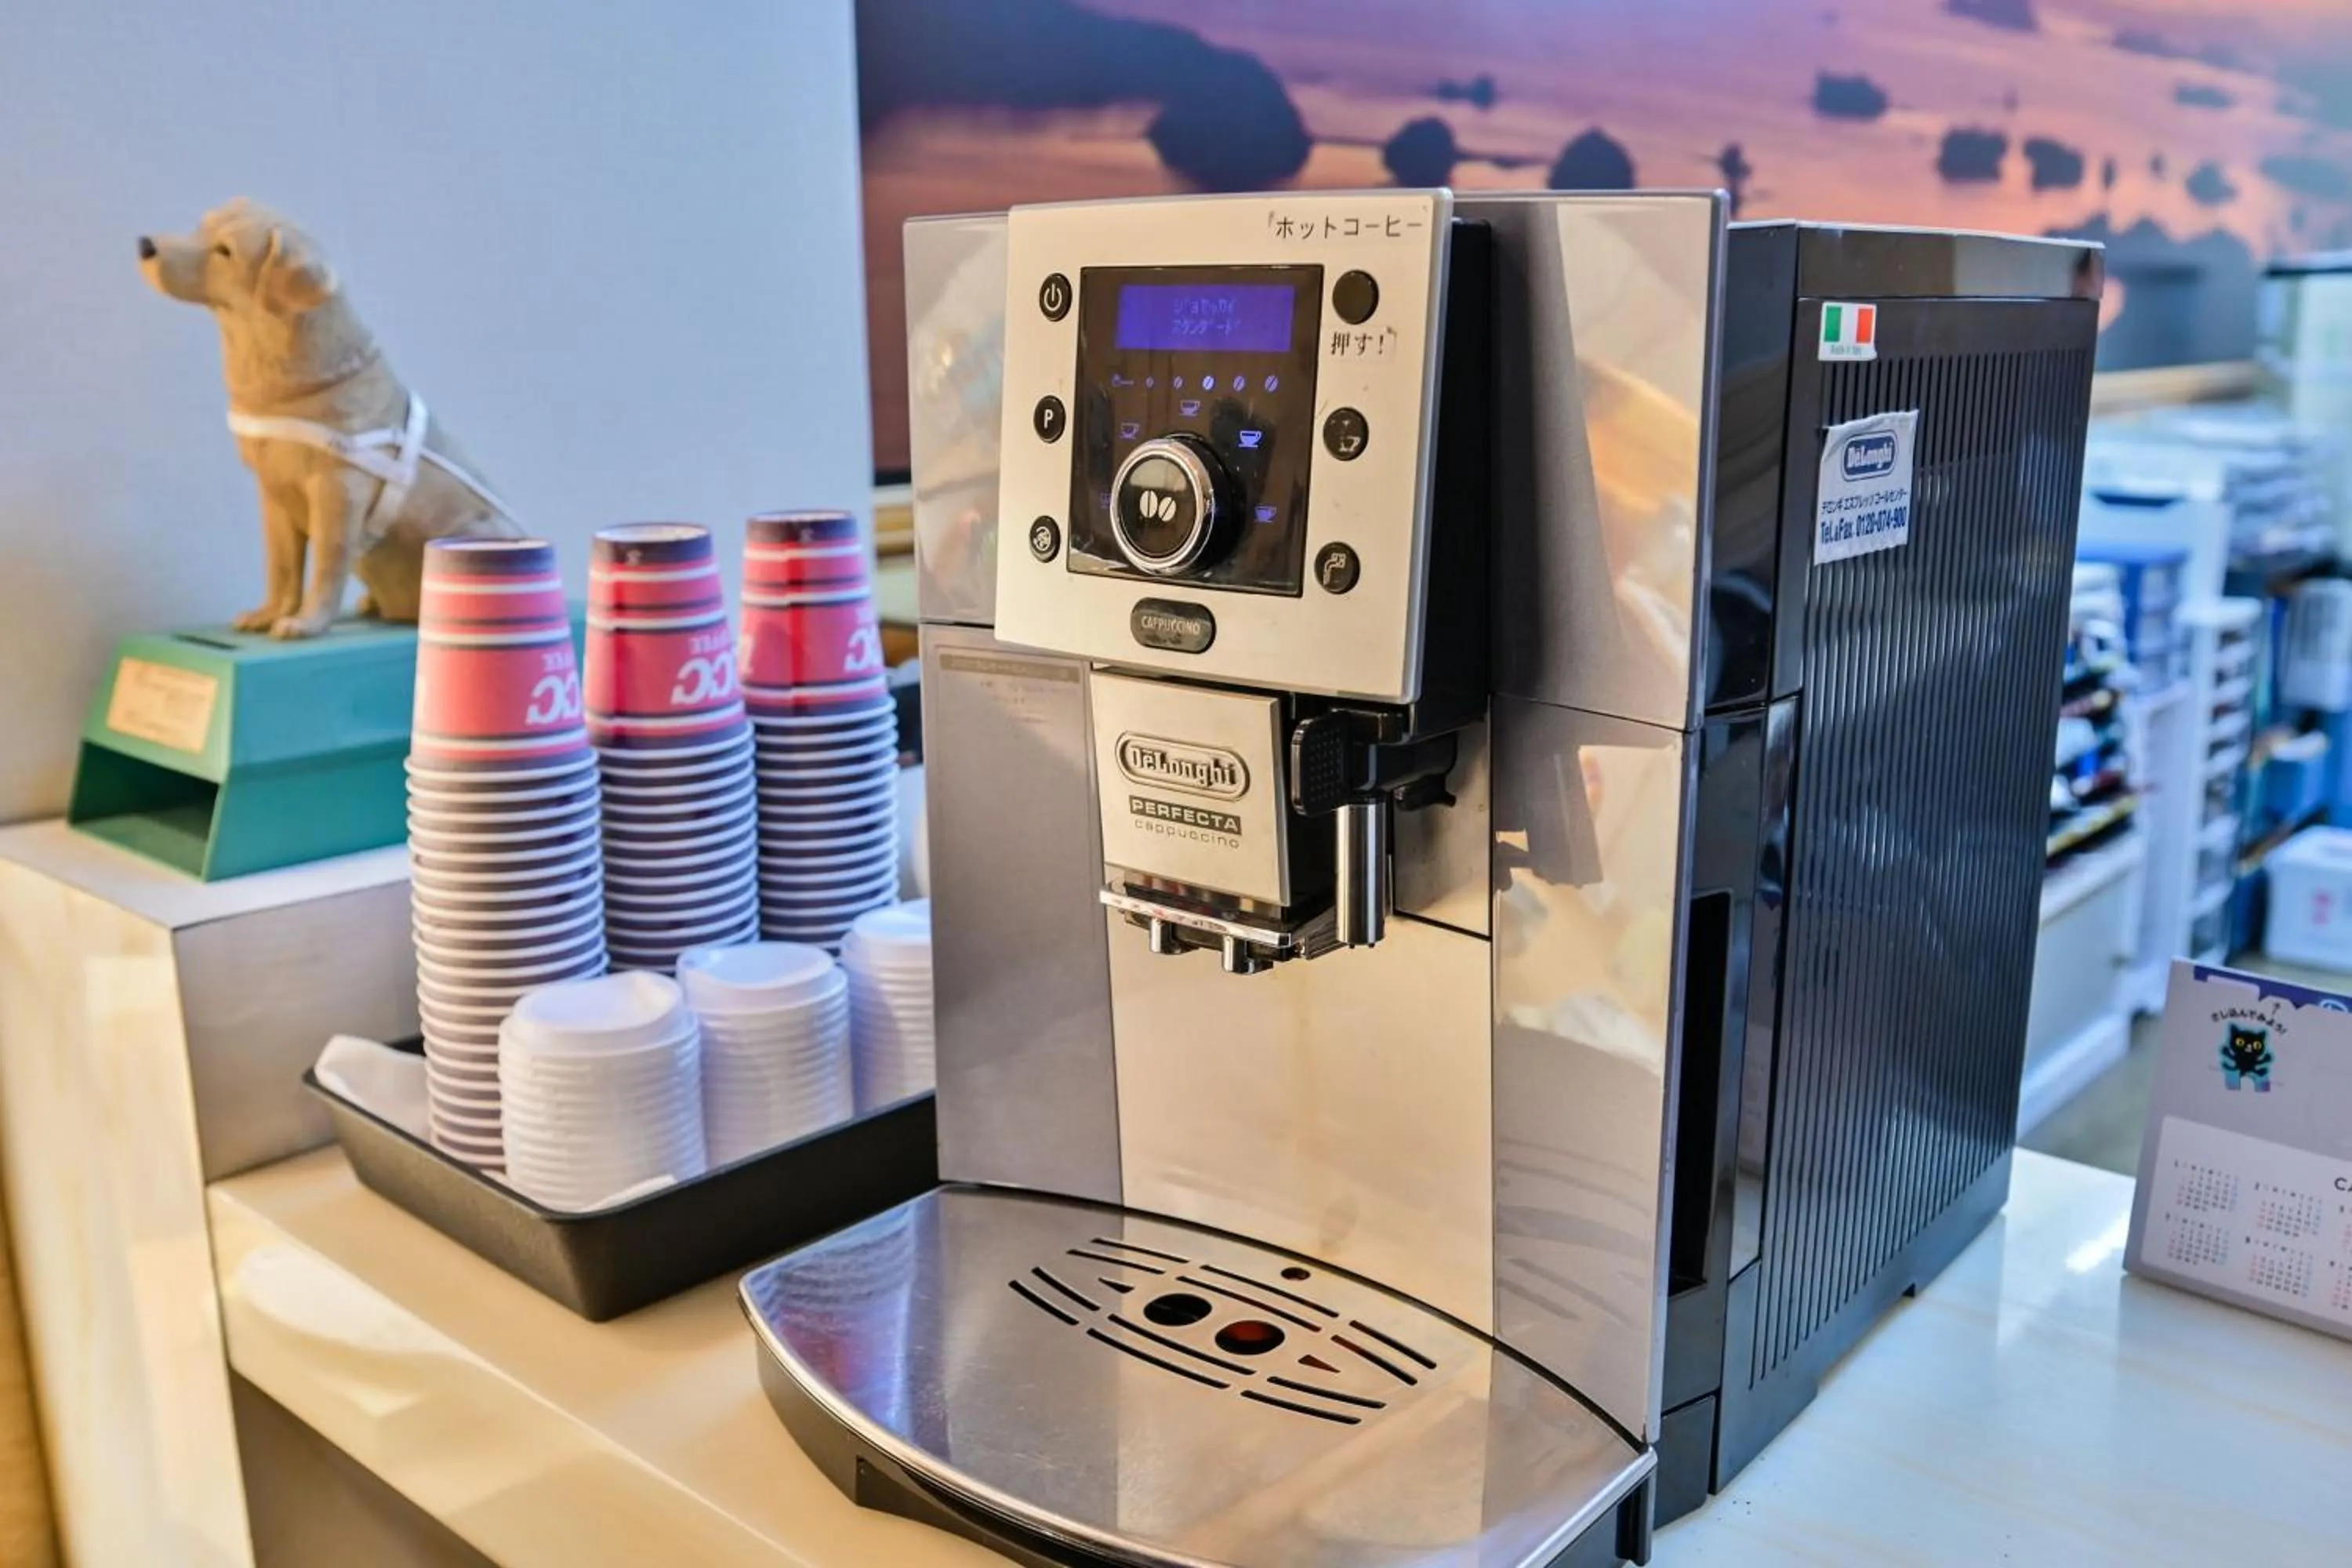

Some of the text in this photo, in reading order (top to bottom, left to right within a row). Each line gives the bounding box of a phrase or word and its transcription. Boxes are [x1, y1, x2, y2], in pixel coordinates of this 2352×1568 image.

[1044, 408, 1054, 430] P
[671, 656, 735, 706] CC
[1131, 799, 1240, 833] PERFECTA
[1134, 819, 1240, 850] cappuccino
[2334, 1177, 2352, 1192] C
